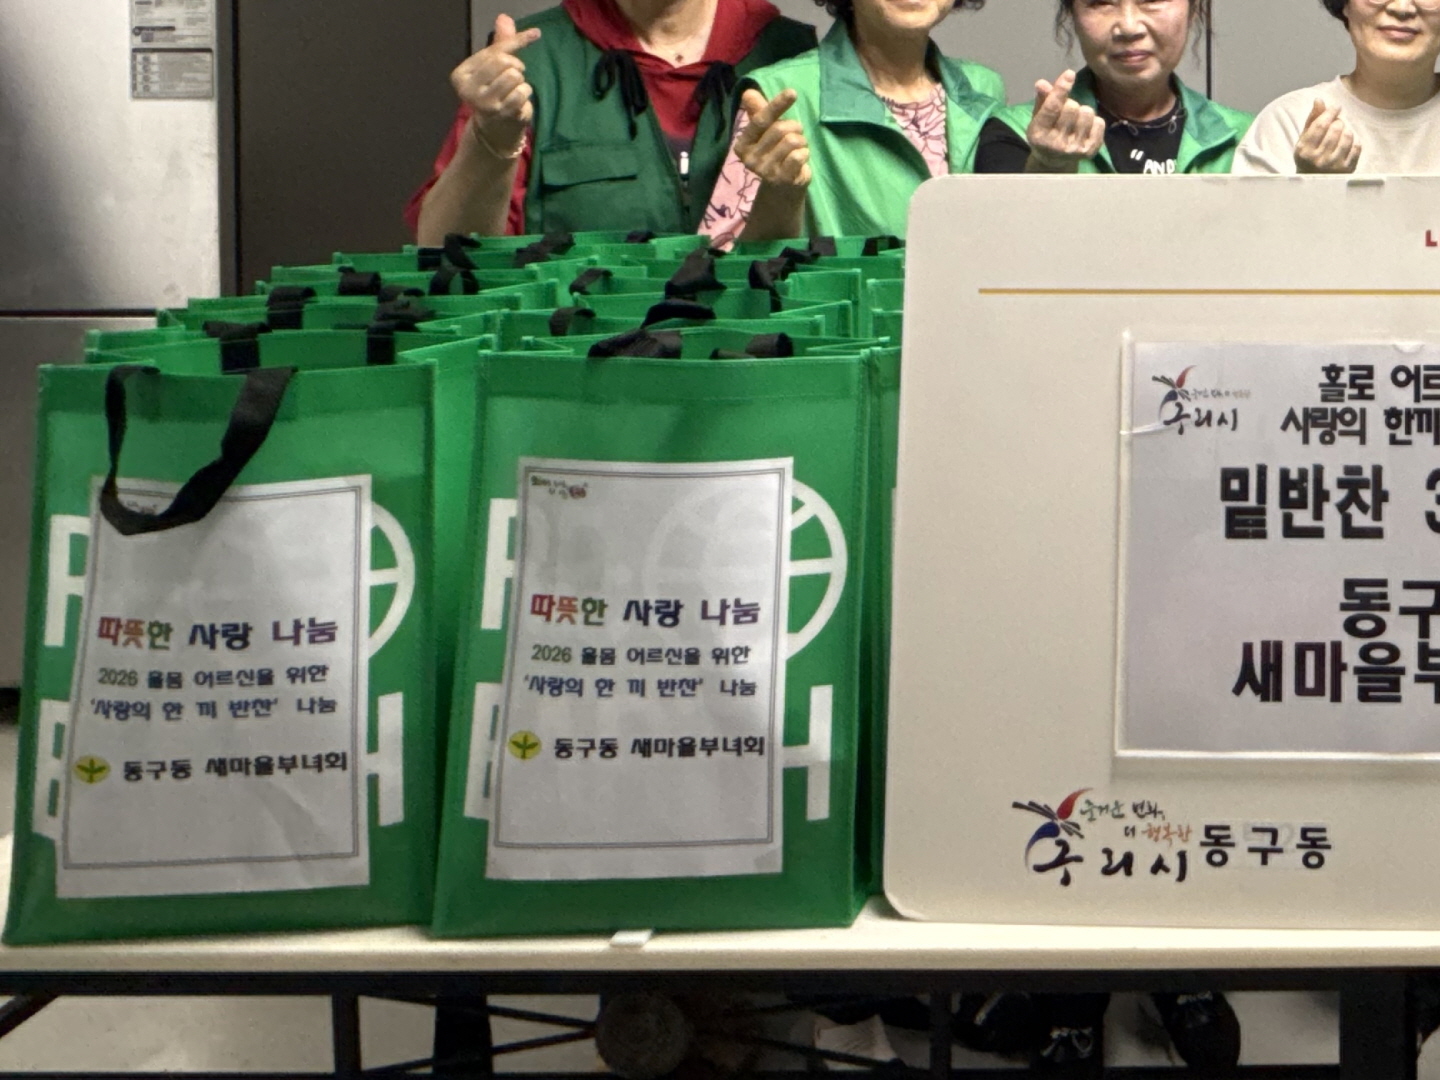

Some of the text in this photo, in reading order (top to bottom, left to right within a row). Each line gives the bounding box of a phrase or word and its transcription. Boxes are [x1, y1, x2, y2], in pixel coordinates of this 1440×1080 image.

[1319, 364, 1375, 403] 홀로
[1280, 407, 1366, 445] 사랑의
[1384, 407, 1440, 445] 한끼
[1220, 464, 1389, 540] 밑반찬
[531, 594, 760, 628] 따뜻한 사랑 나눔
[98, 617, 338, 651] 따뜻한 사랑 나눔
[531, 644, 572, 663] 2026
[627, 648, 701, 665] 어르신을
[98, 668, 138, 687] 2026
[194, 669, 274, 688] 어르신을
[719, 679, 756, 697] 나눔
[297, 697, 336, 714] 나눔
[554, 736, 764, 759] 동구동 새마을부녀회
[124, 752, 347, 782] 동구동 새마을부녀회
[1200, 825, 1331, 870] 동구동
